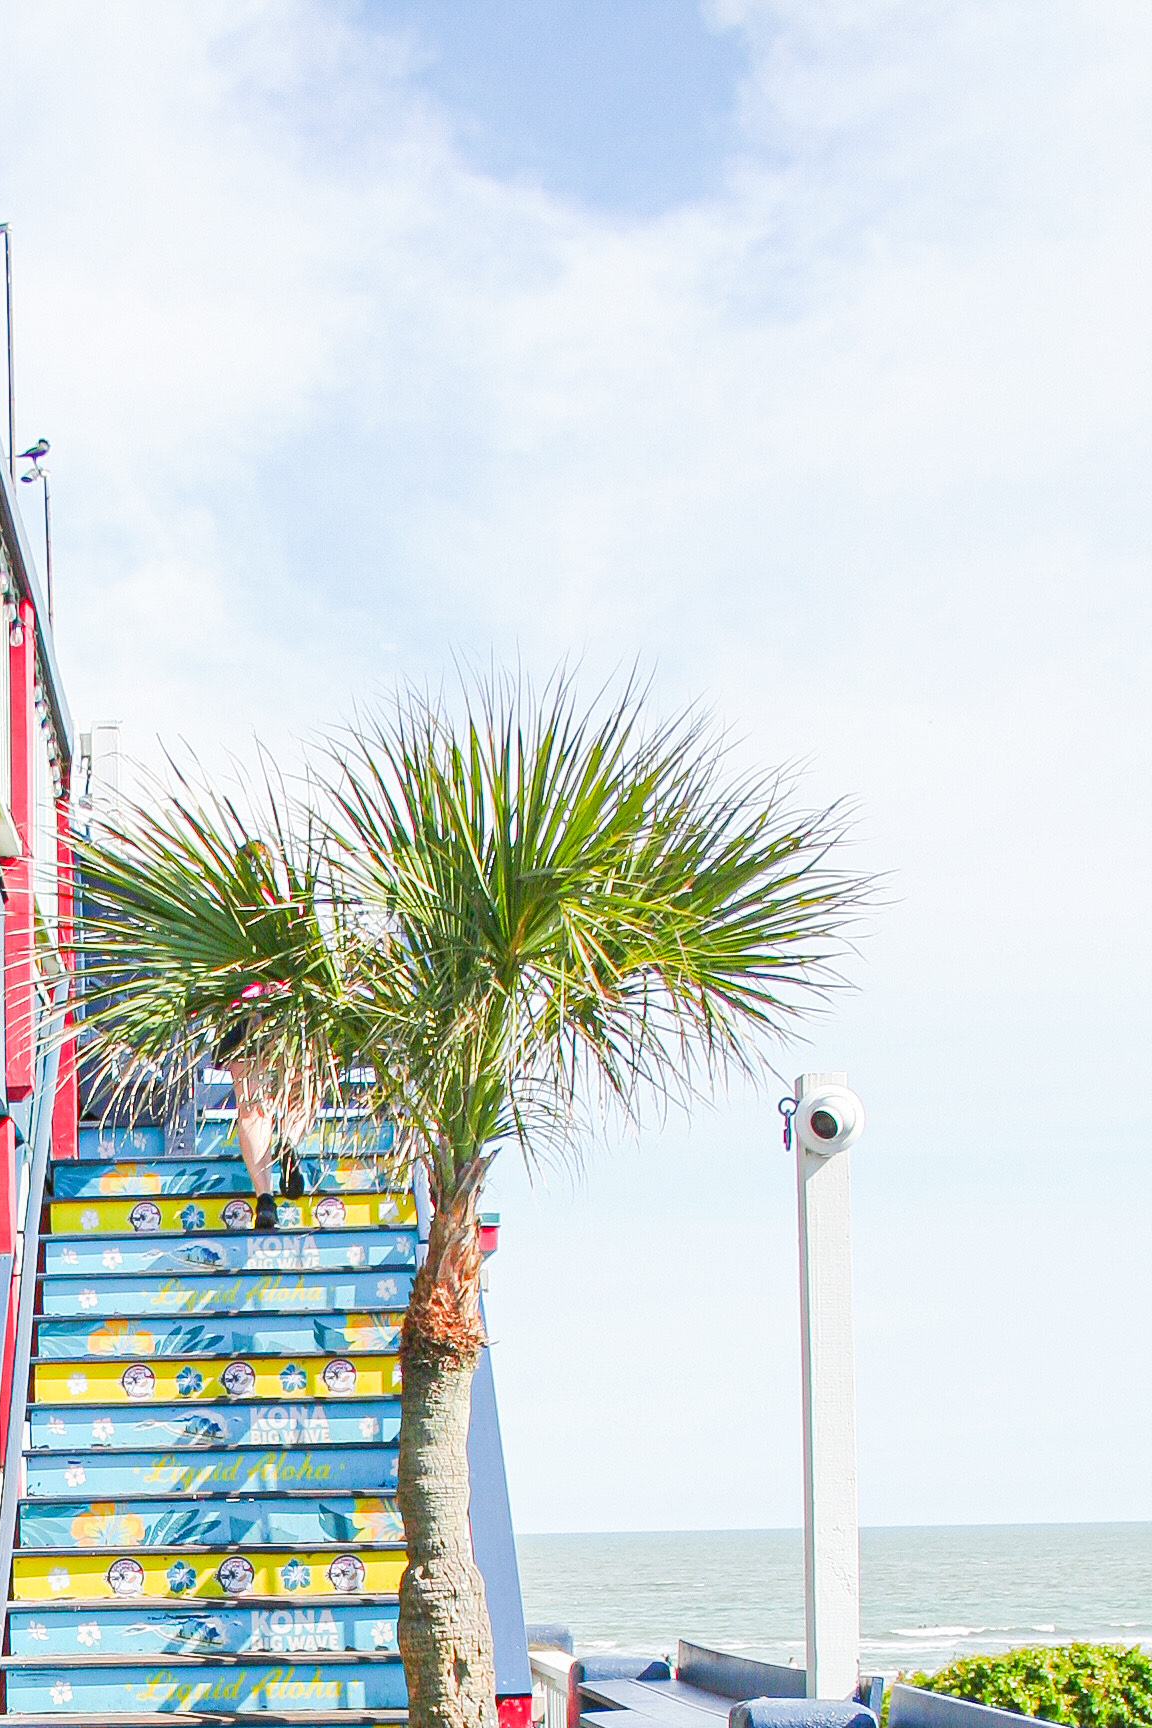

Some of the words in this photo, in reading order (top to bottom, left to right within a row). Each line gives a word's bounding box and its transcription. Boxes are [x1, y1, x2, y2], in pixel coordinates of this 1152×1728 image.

[247, 1235, 319, 1258] KONA
[151, 1278, 242, 1311] Liquid
[246, 1275, 323, 1304] Aloha
[249, 1406, 330, 1430] KONA
[250, 1430, 280, 1445] BIG
[286, 1429, 331, 1444] WAVE
[144, 1454, 244, 1493] Liquid
[248, 1452, 331, 1482] Aloha
[251, 1609, 338, 1635] KONA
[251, 1635, 282, 1651] BIG
[289, 1633, 339, 1651] WAVE
[136, 1671, 247, 1708] Liquid
[251, 1667, 343, 1701] Aloha
